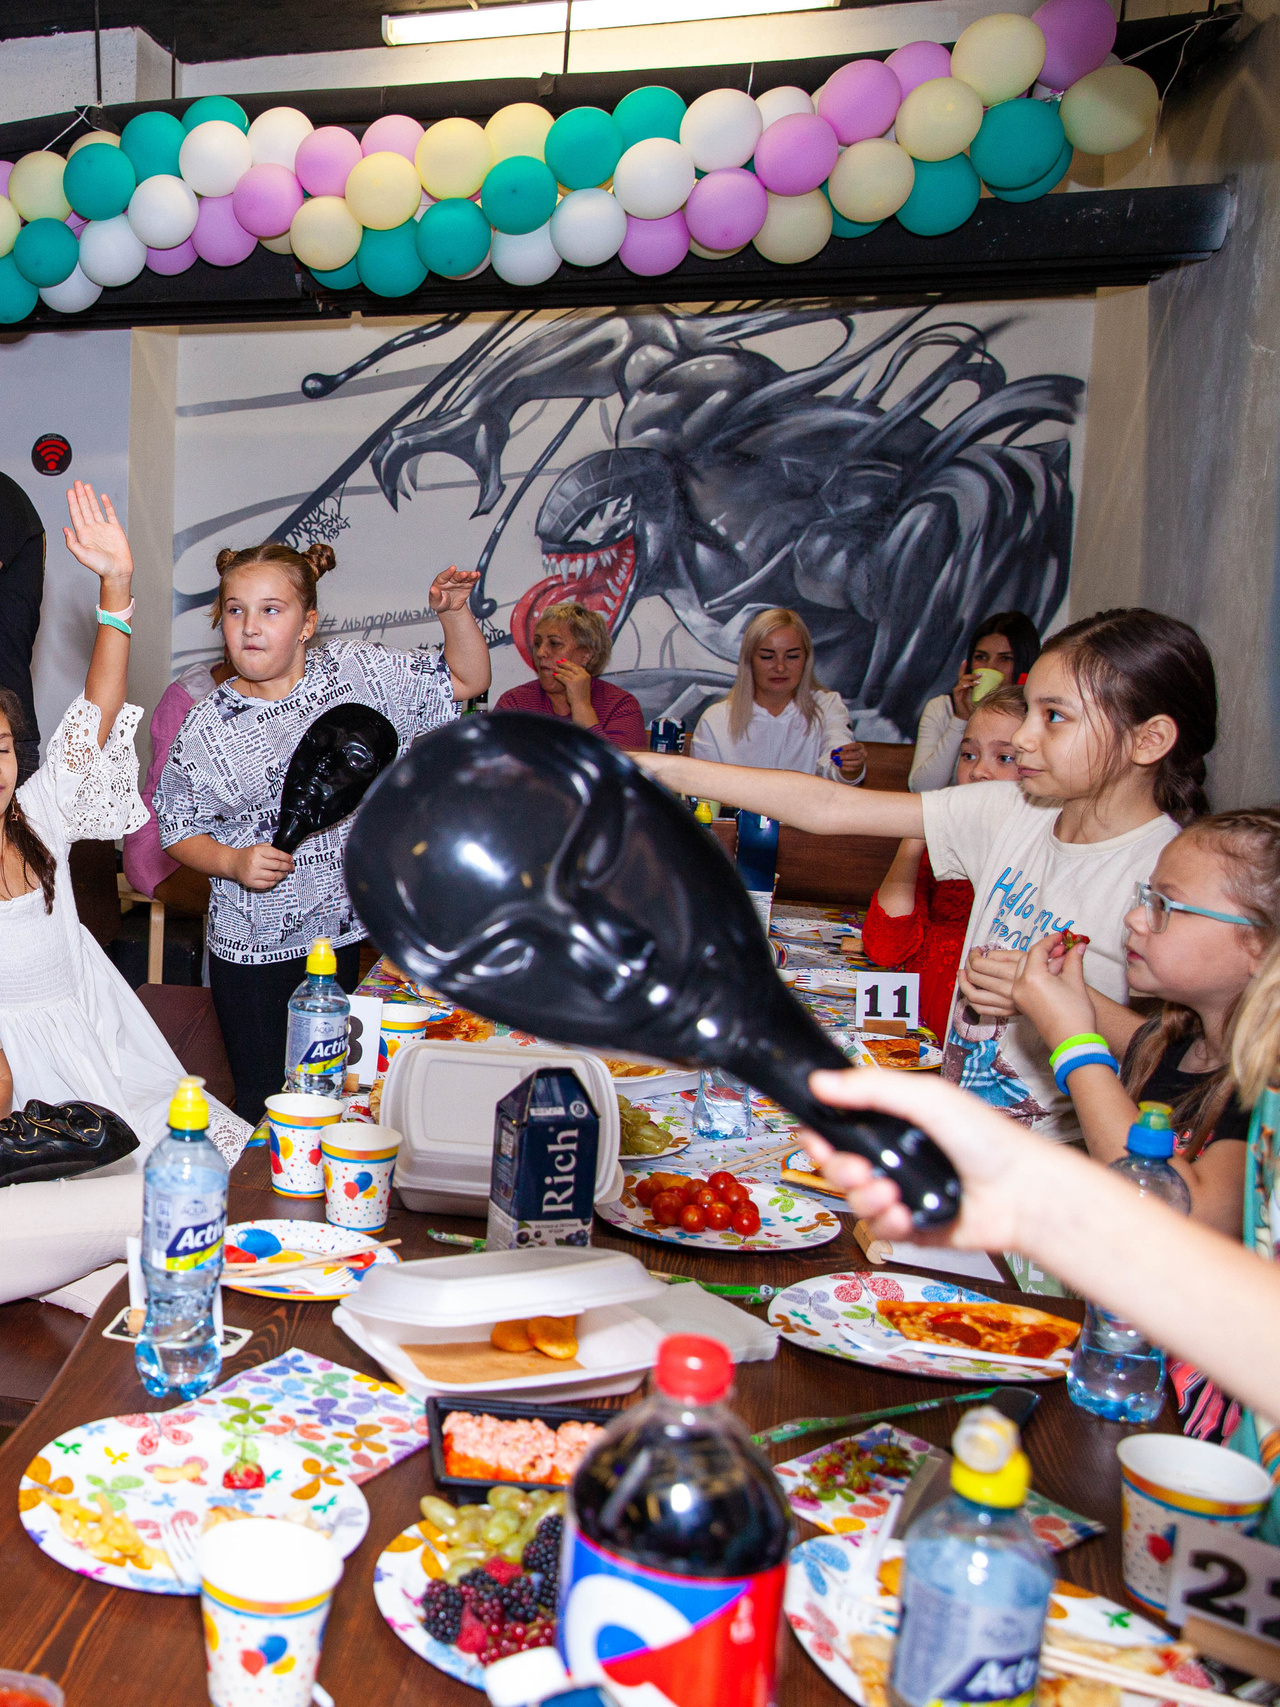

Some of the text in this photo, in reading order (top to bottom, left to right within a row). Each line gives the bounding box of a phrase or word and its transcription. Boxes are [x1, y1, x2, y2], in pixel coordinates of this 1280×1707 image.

[256, 697, 301, 724] silence
[305, 690, 318, 703] is
[298, 705, 314, 719] an
[240, 954, 255, 964] is
[261, 947, 307, 963] silence
[865, 985, 911, 1018] 11
[542, 1128, 579, 1214] Rich
